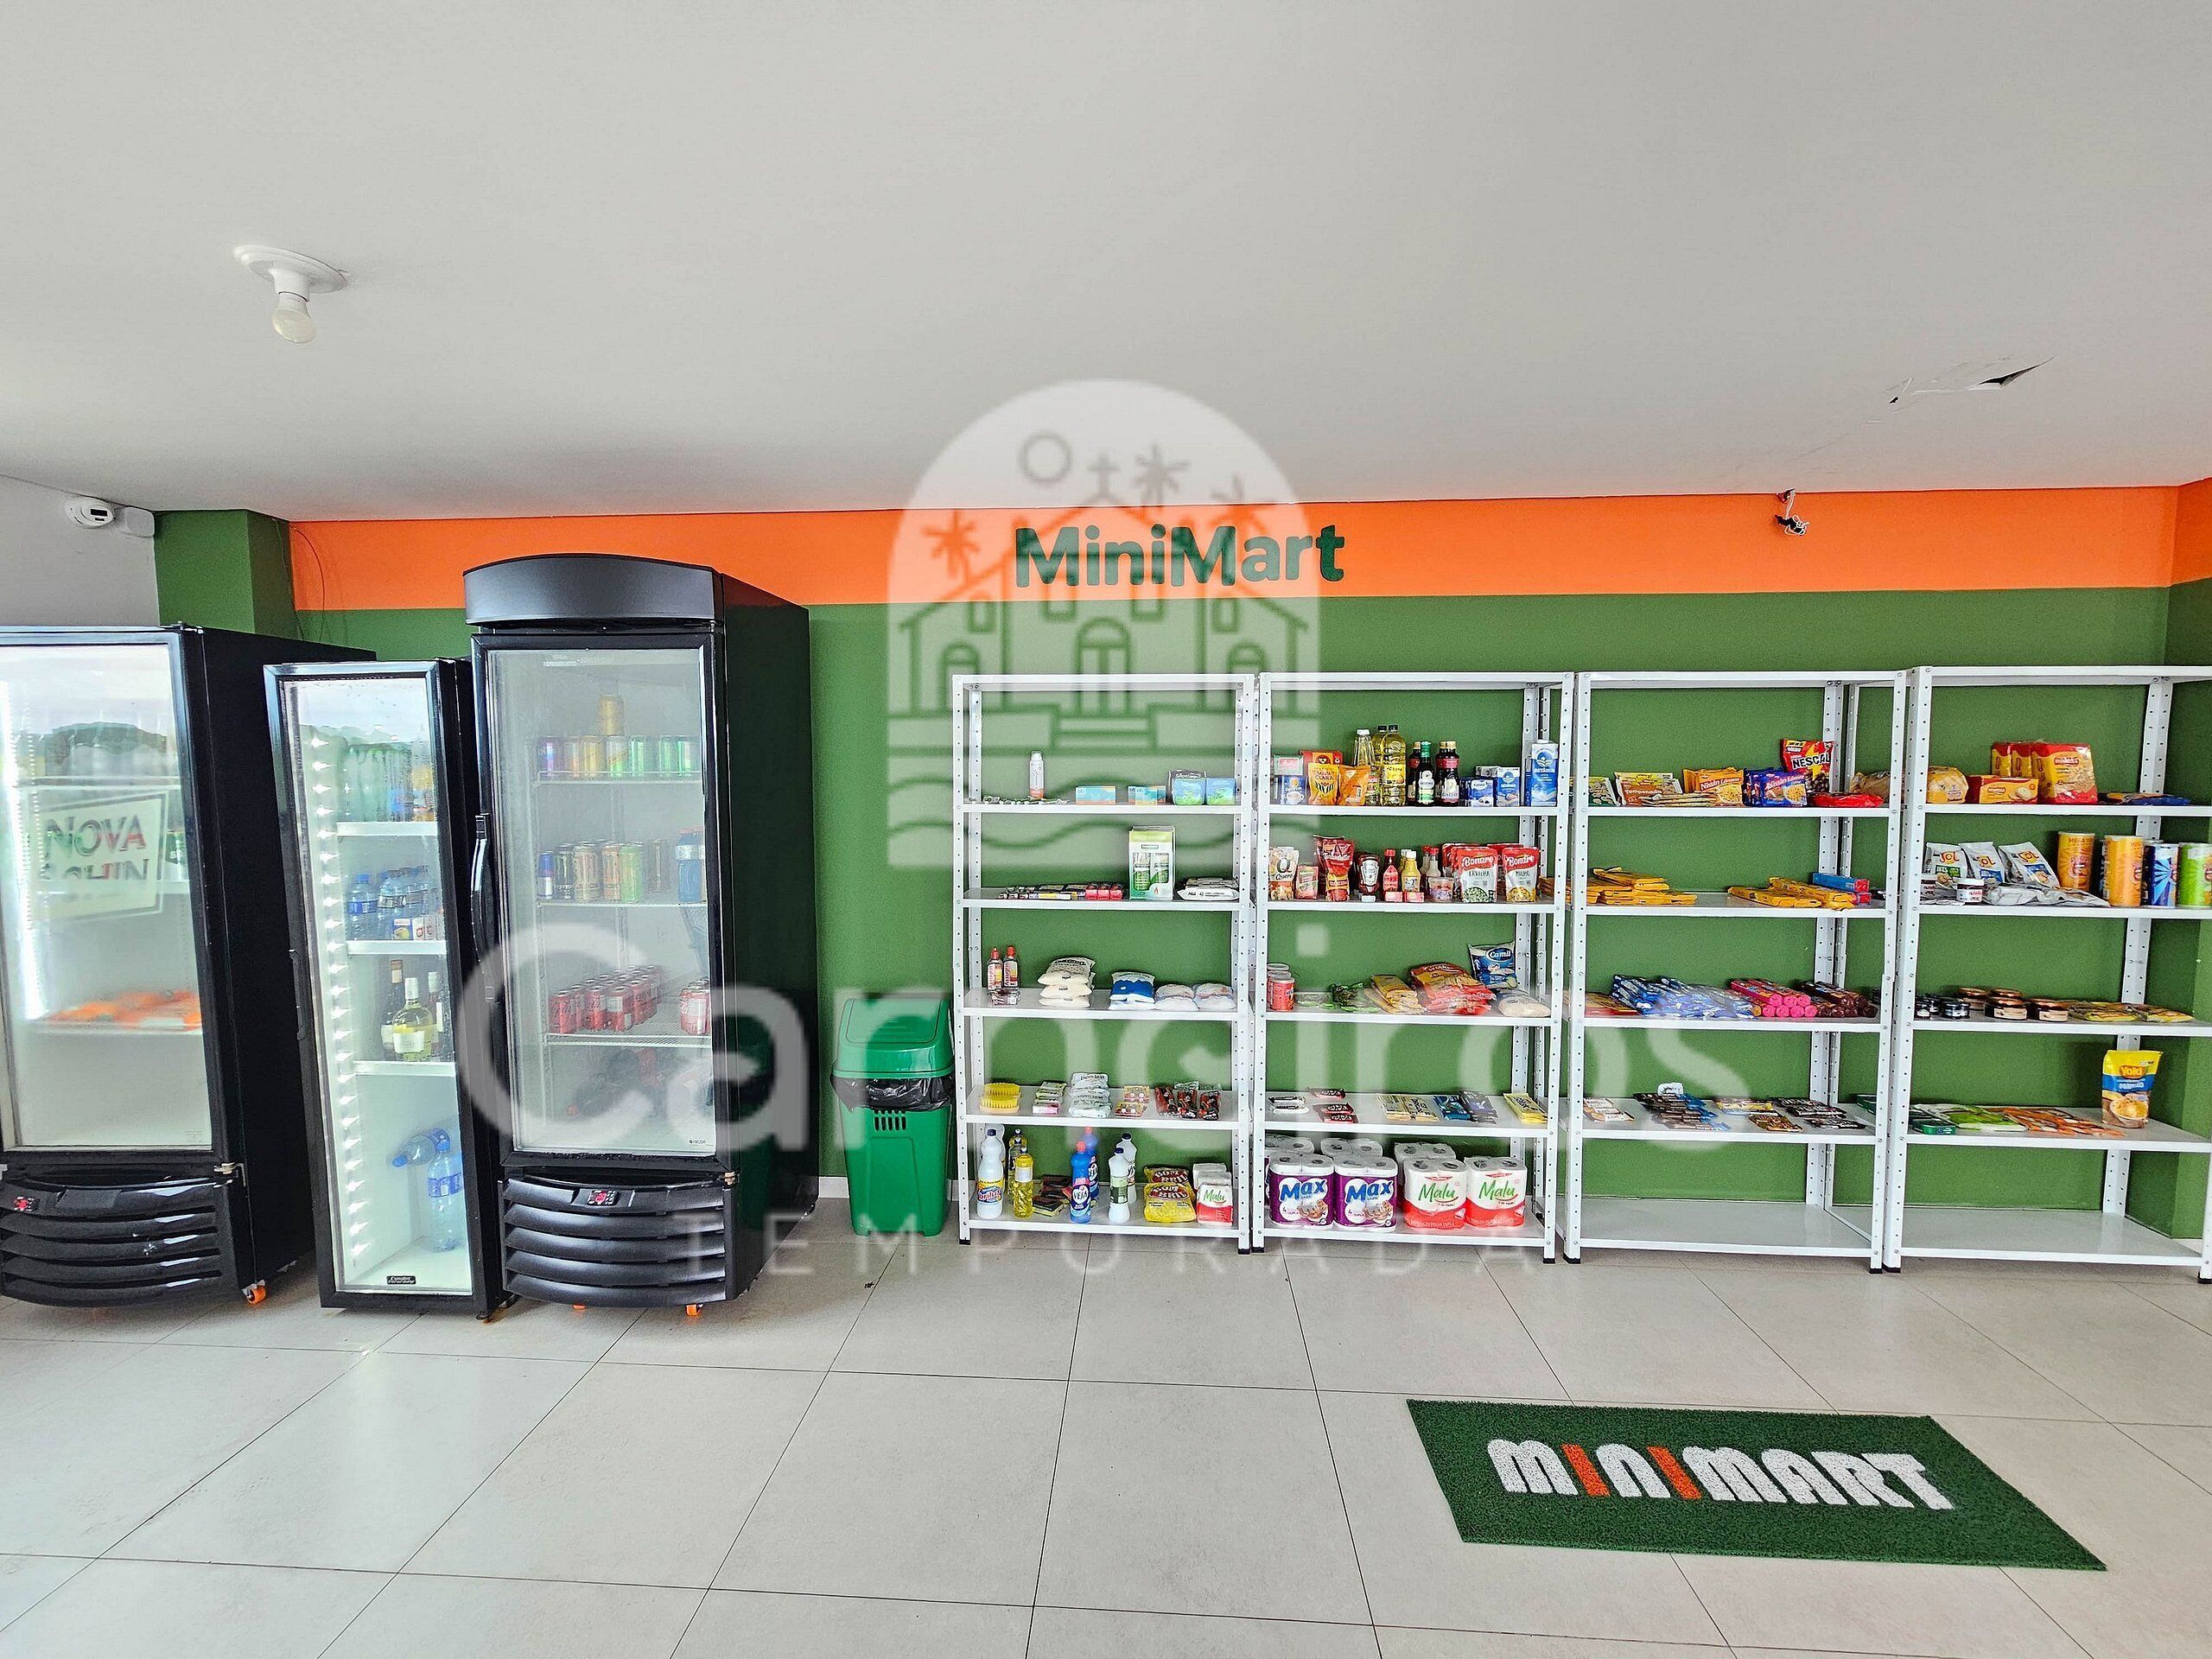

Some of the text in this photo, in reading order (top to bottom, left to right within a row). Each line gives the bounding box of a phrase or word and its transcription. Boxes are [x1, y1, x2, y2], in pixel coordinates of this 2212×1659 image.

[1014, 524, 1344, 588] MiniMart
[1700, 780, 1720, 791] Nissin
[1490, 950, 1511, 958] Camil
[1074, 1190, 1088, 1200] VEJA
[1204, 1189, 1225, 1201] Malu
[1281, 1180, 1326, 1201] Max
[1346, 1181, 1393, 1203] Max
[1418, 1183, 1455, 1202] Malu
[1478, 1179, 1515, 1200] Malu
